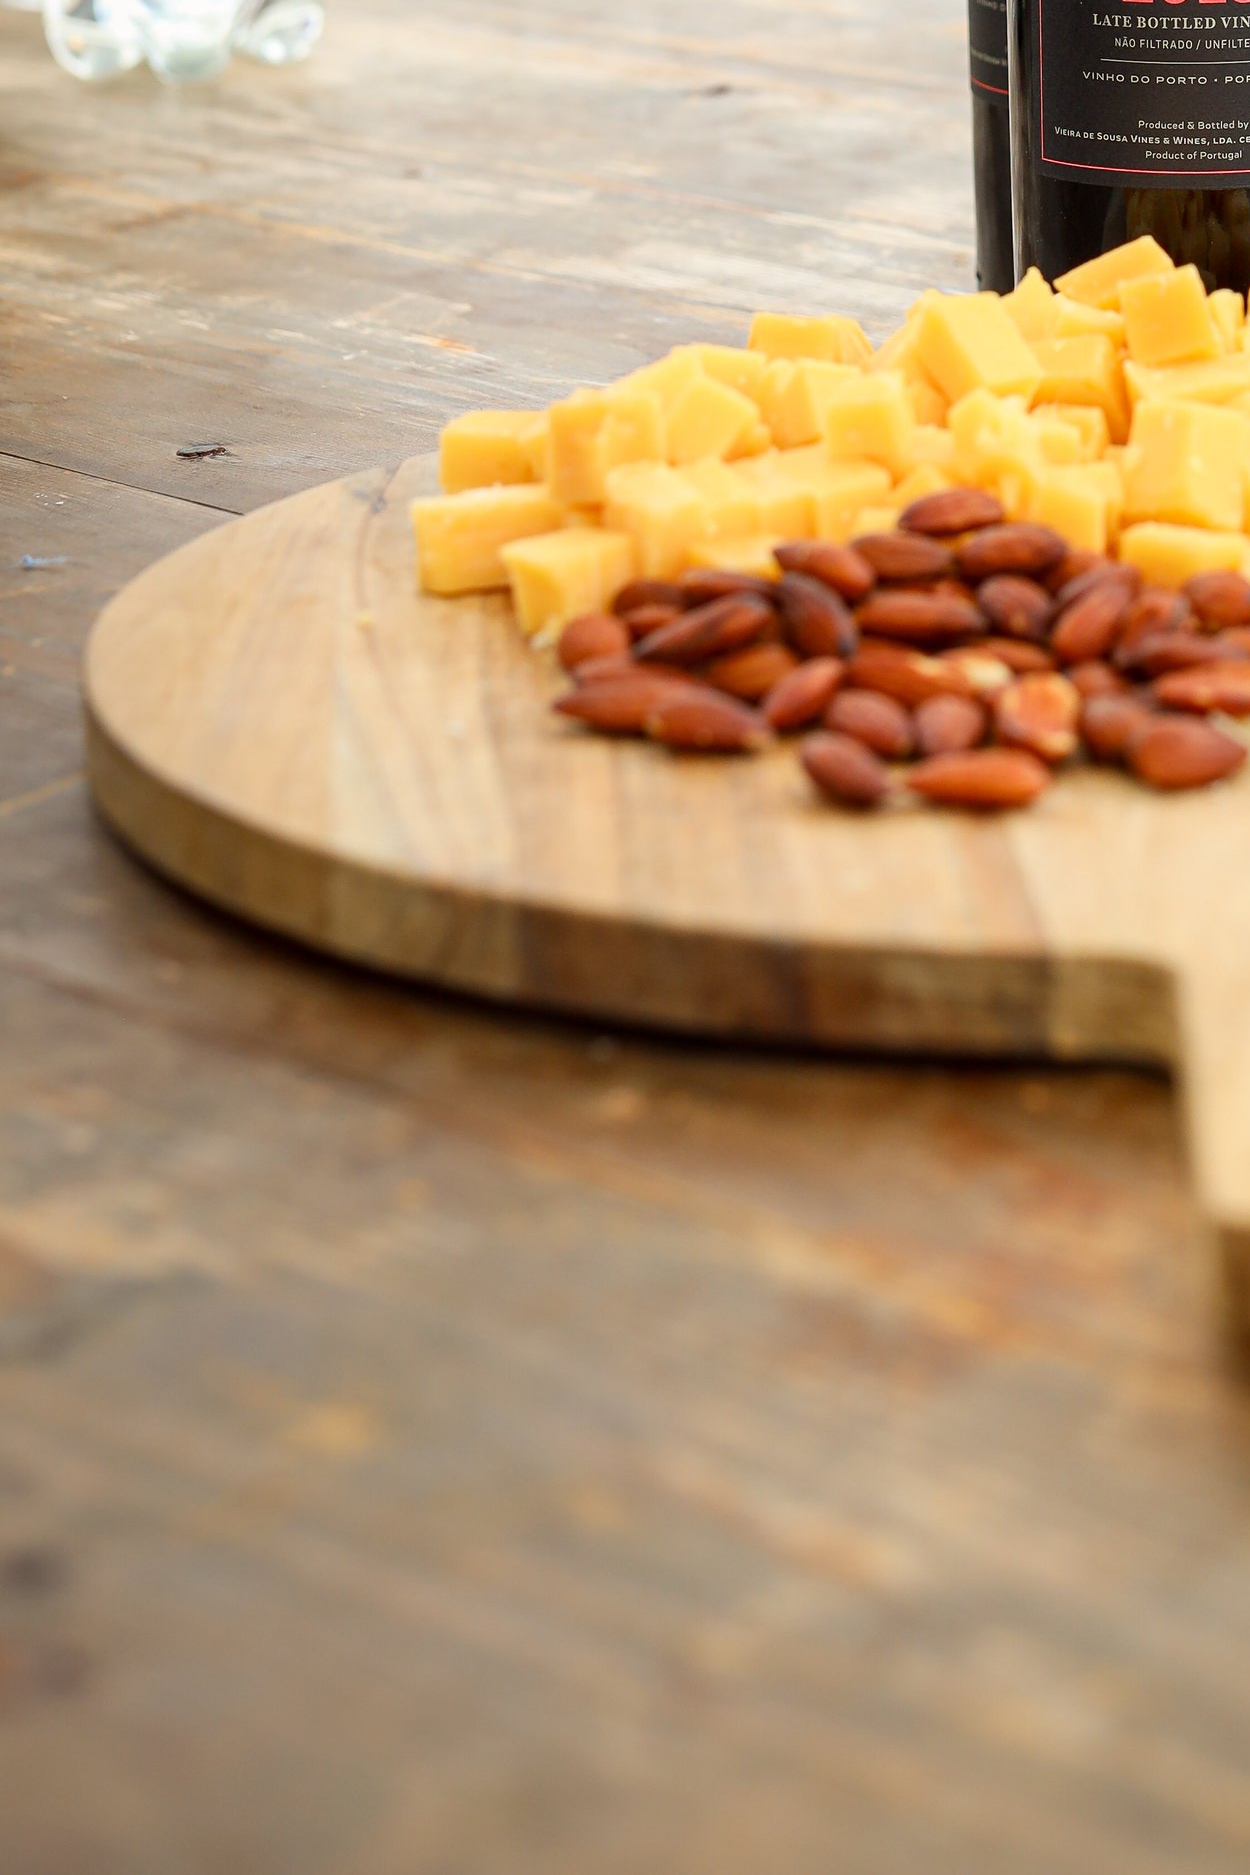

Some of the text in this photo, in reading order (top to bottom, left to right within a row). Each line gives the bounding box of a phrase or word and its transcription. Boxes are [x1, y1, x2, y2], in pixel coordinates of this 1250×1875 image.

[1092, 13, 1132, 28] LATE
[1136, 16, 1216, 30] BOTTLED
[1114, 36, 1136, 48] NÃO
[1139, 38, 1193, 50] FILTRADO
[1082, 70, 1125, 83] VINHO
[1130, 75, 1150, 84] DO
[1156, 76, 1208, 85] PORTO
[1138, 119, 1249, 130] Produced & Bottled by
[1054, 125, 1082, 138] VIEIRA
[1083, 131, 1095, 140] DE
[1096, 131, 1129, 143] SOUSA
[1130, 134, 1161, 145] VINES
[1162, 137, 1170, 145] &
[1145, 149, 1243, 161] Product of Portugal
